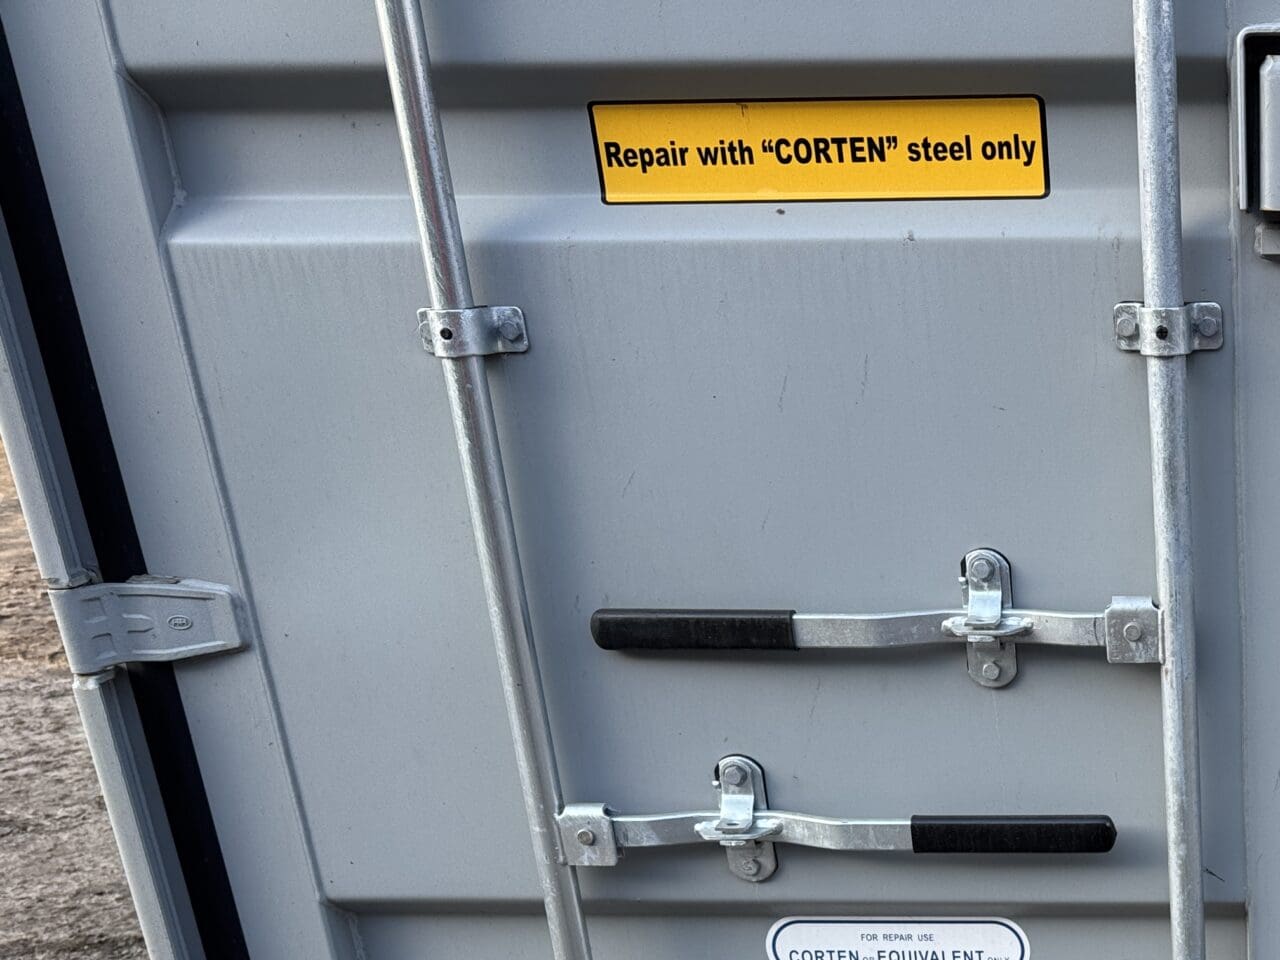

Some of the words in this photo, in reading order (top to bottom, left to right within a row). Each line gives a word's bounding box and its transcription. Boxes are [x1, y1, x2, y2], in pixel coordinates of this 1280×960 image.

[603, 141, 690, 174] Repair
[698, 139, 755, 166] with
[761, 135, 899, 165] “CORTEN”
[907, 135, 972, 162] steel
[981, 133, 1037, 167] only
[860, 933, 879, 942] FOR
[882, 933, 913, 942] REPAIR
[917, 933, 935, 942] USE
